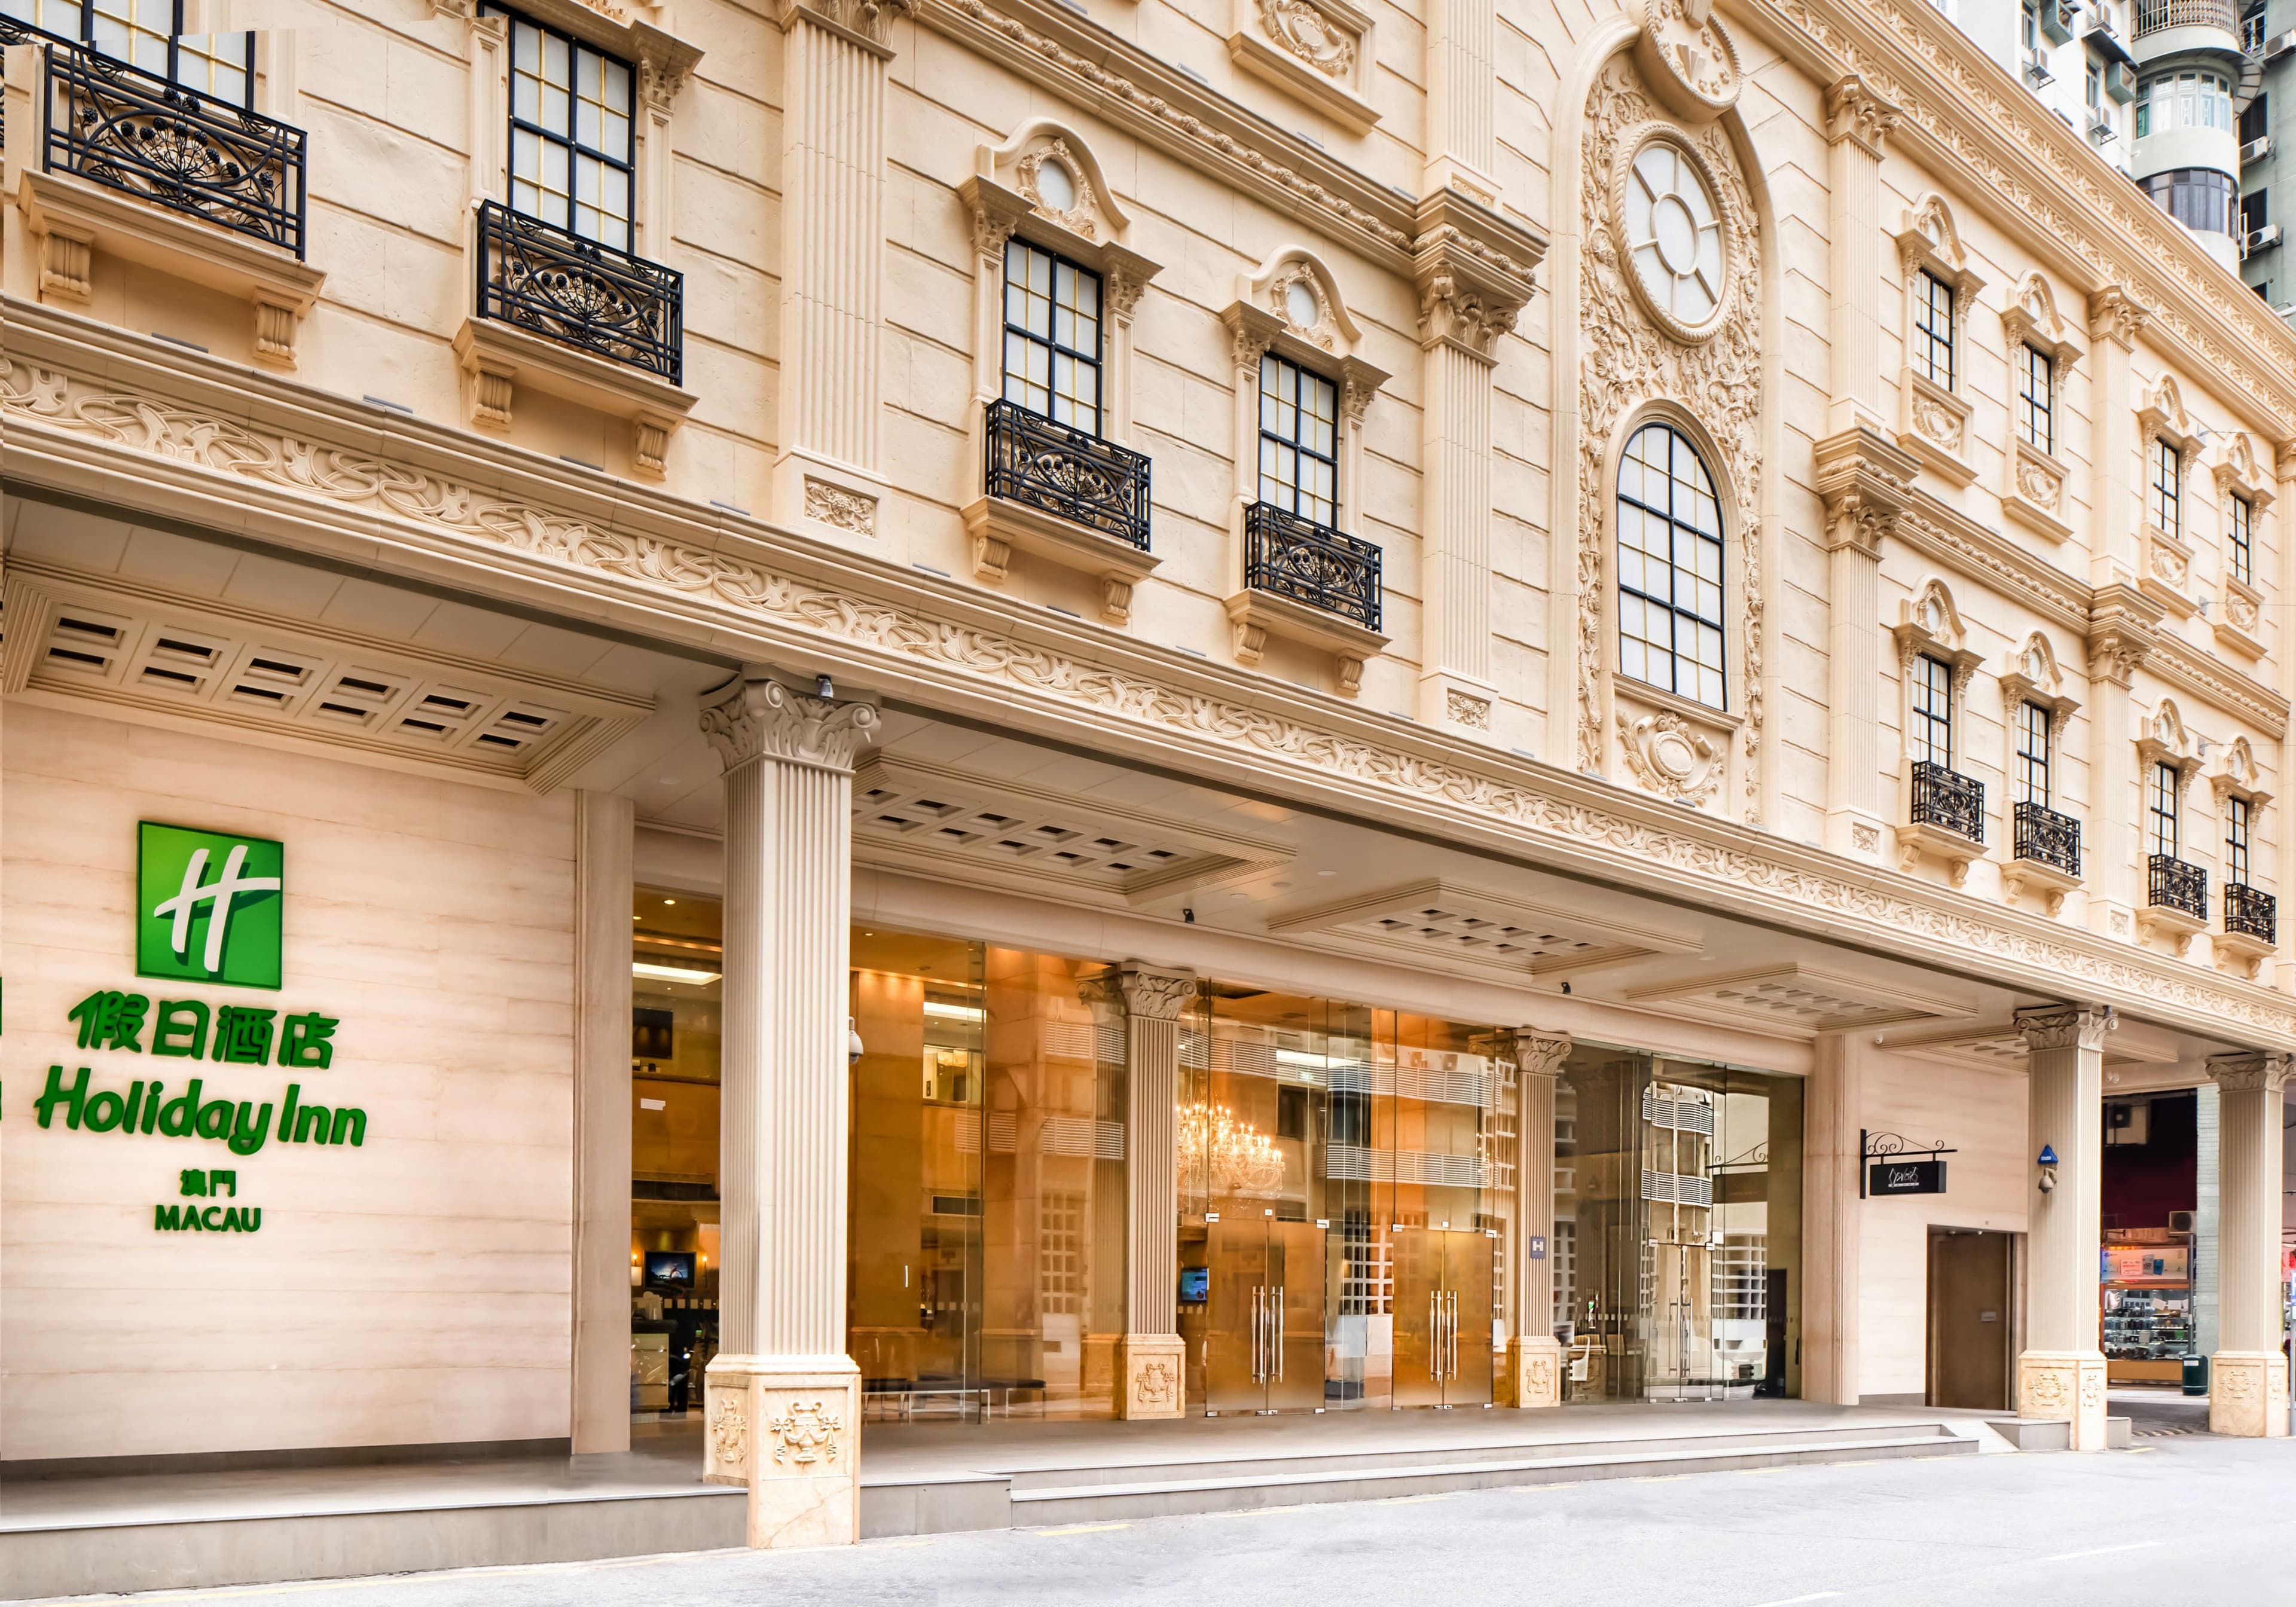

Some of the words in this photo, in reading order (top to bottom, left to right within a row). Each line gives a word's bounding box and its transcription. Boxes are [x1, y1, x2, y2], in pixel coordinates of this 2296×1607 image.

[68, 990, 339, 1069] 假日酒店
[34, 1065, 273, 1156] Holiday
[277, 1083, 367, 1147] Inn
[155, 1205, 261, 1232] MACAU
[1533, 1241, 1544, 1251] H
